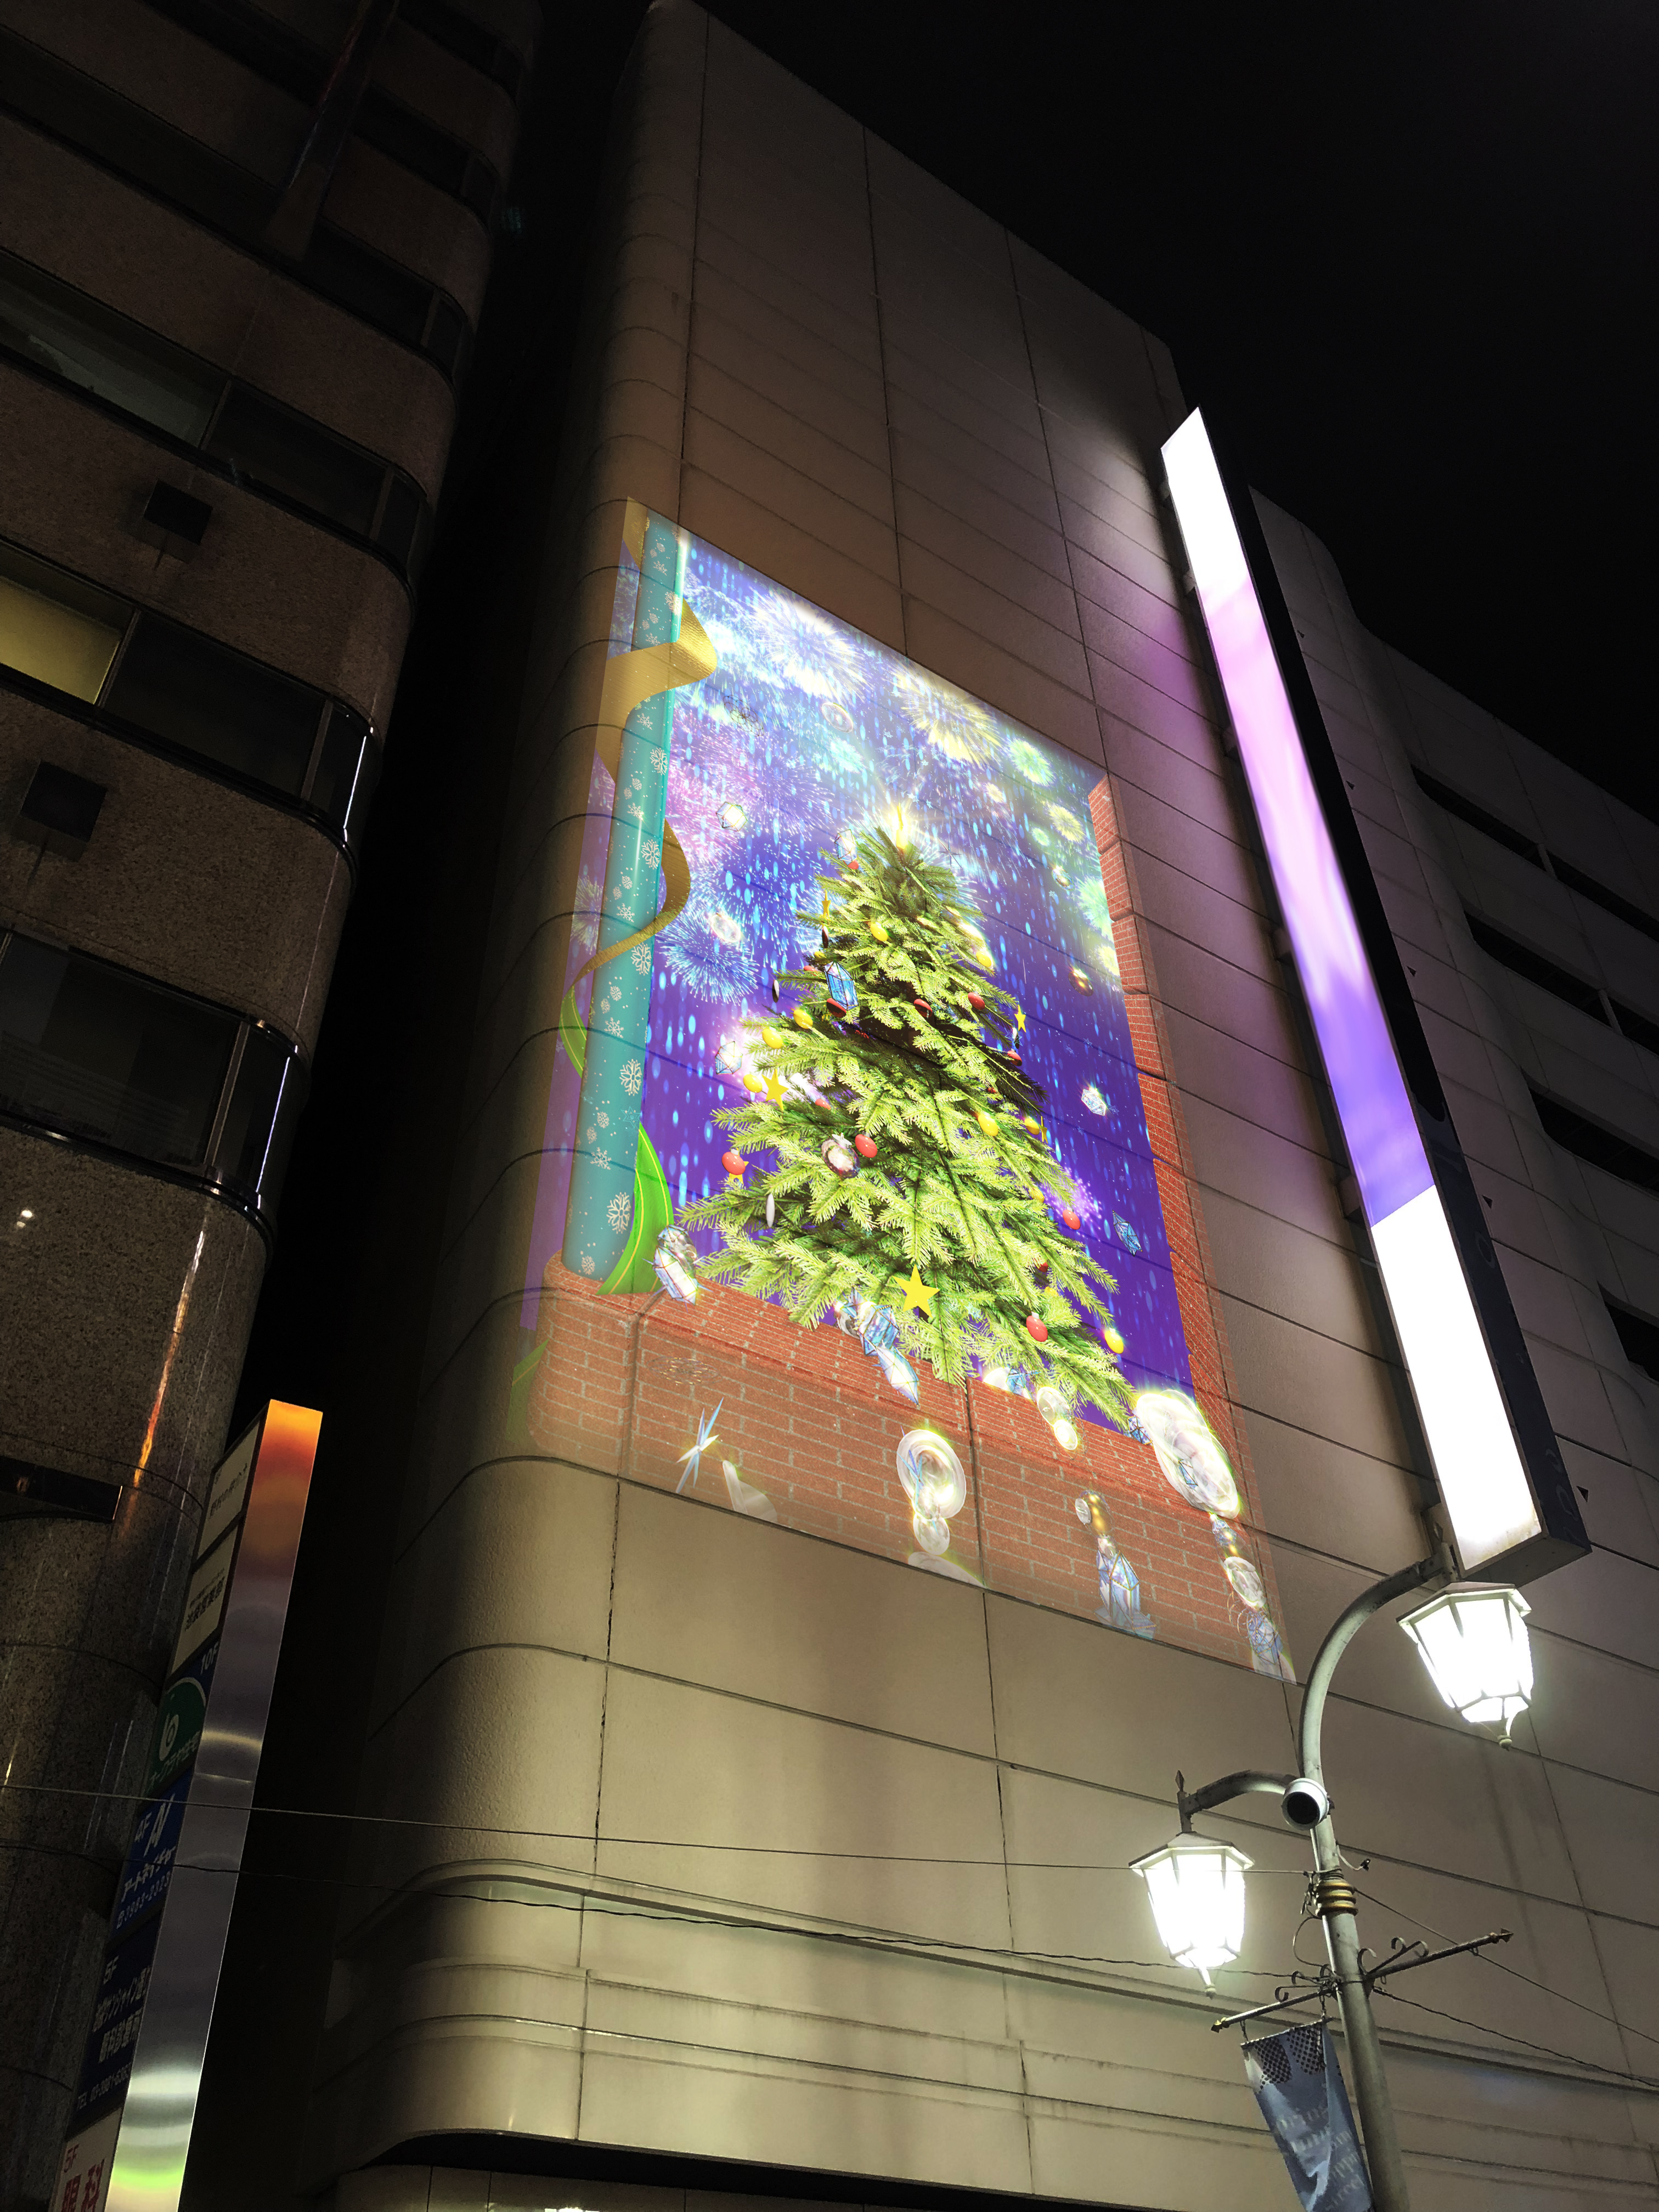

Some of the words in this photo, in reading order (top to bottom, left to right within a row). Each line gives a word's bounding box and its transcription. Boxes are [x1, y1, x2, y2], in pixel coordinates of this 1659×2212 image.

[134, 1811, 153, 1843] 4F
[103, 1955, 120, 1984] 5F
[64, 2143, 80, 2173] 5F
